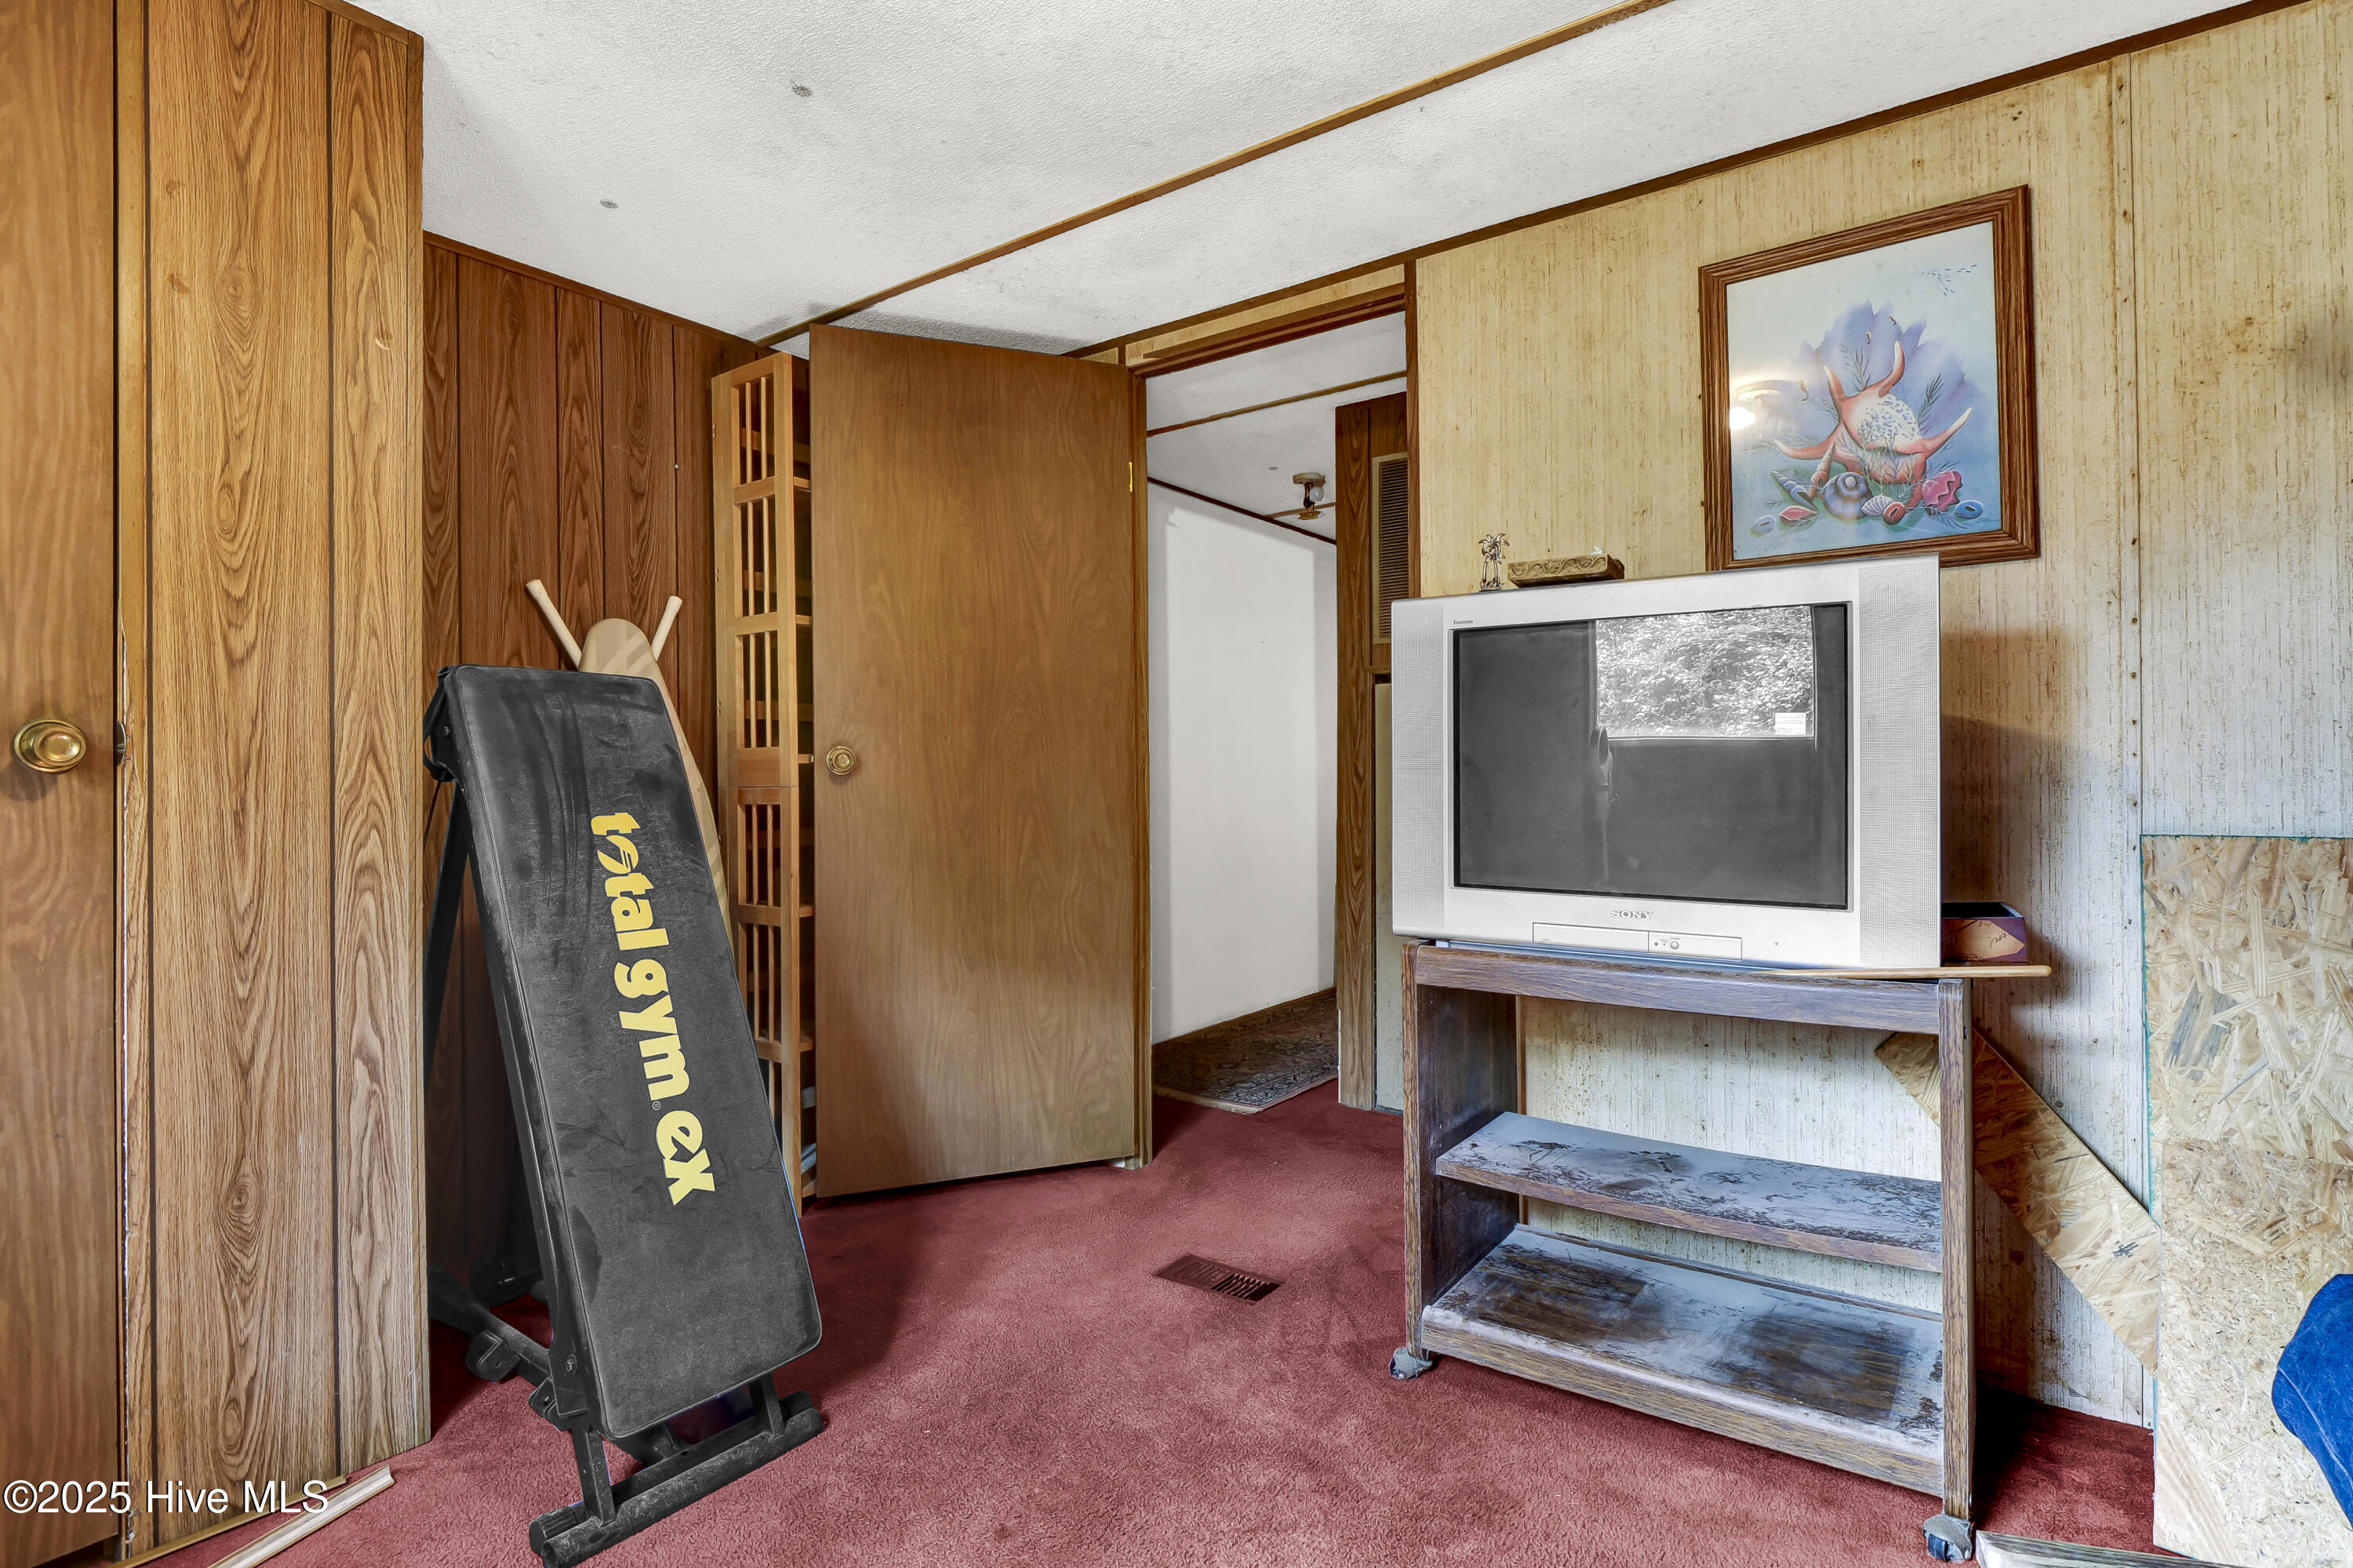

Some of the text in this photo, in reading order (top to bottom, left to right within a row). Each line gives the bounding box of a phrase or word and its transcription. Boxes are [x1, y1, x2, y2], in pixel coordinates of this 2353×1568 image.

[591, 813, 669, 950] total
[656, 1110, 715, 1205] ex
[1610, 909, 1653, 919] SONY
